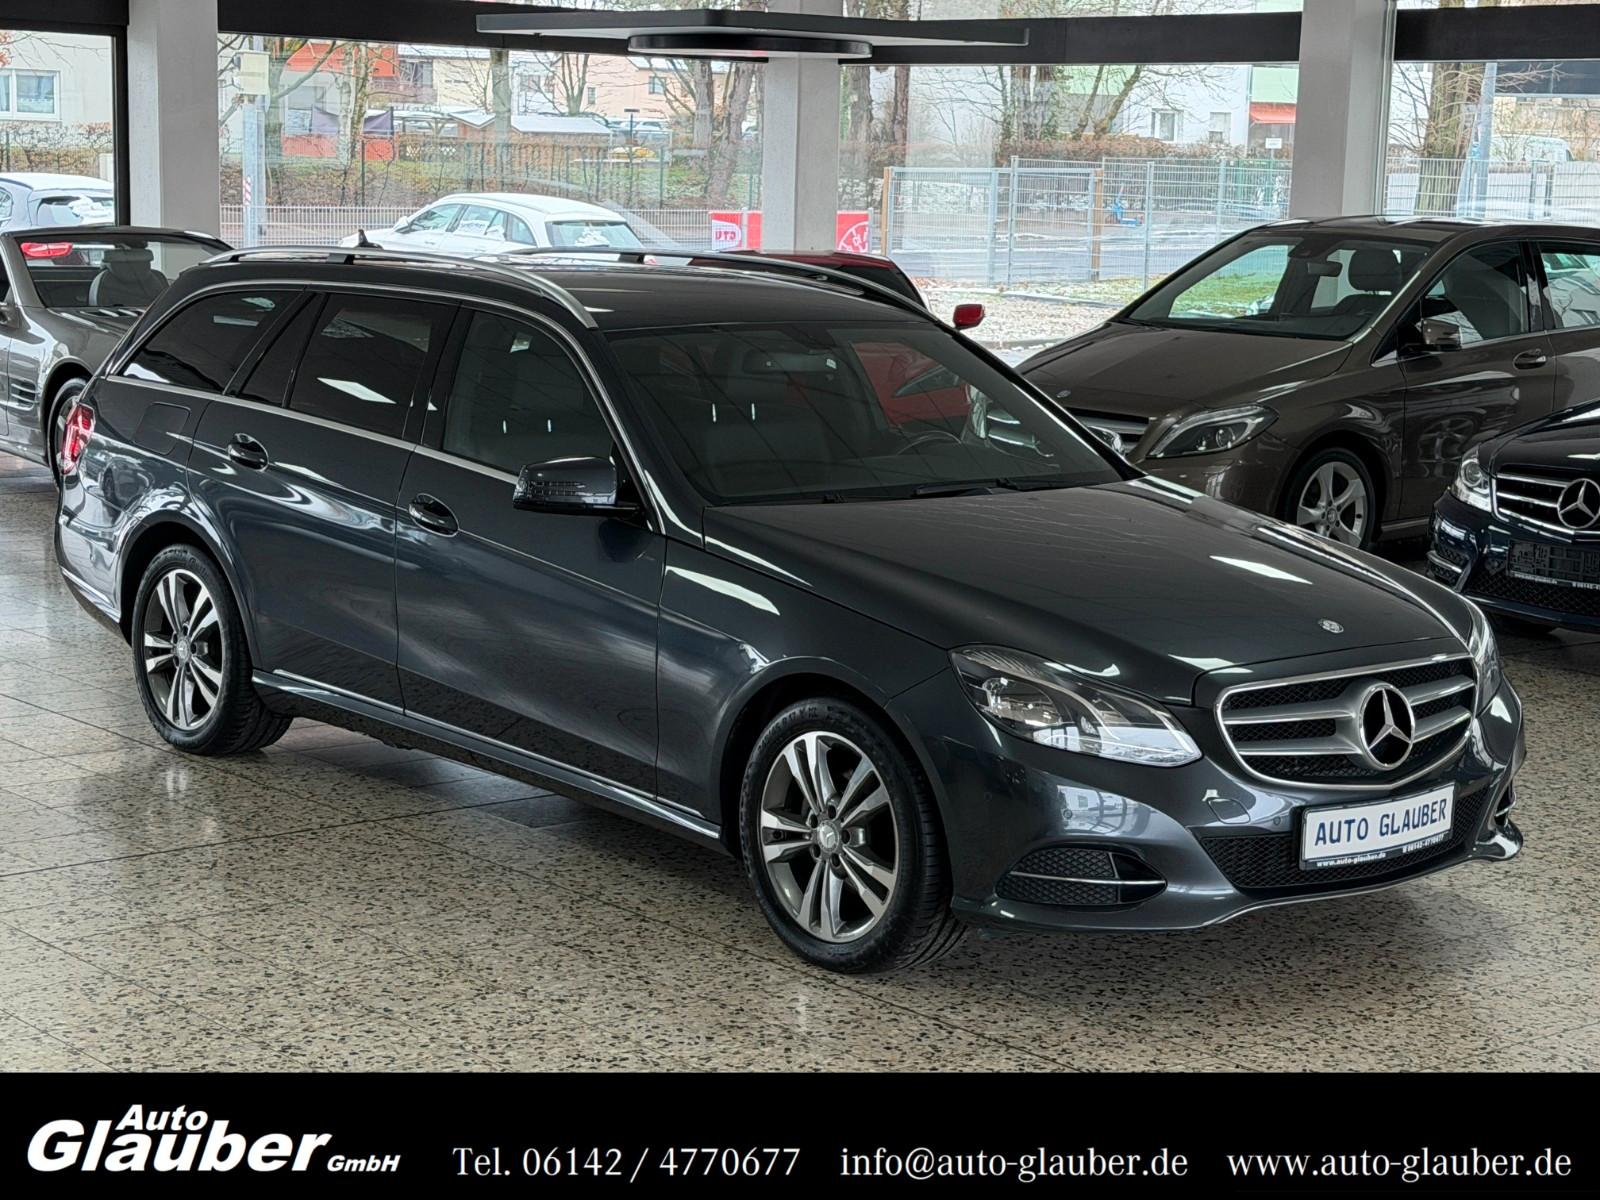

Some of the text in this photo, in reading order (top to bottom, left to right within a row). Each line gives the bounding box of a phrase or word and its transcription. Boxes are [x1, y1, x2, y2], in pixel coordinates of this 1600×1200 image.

[1314, 798, 1448, 846] AUTO GLAUBER
[1316, 851, 1387, 867] www.auto-glauber.de
